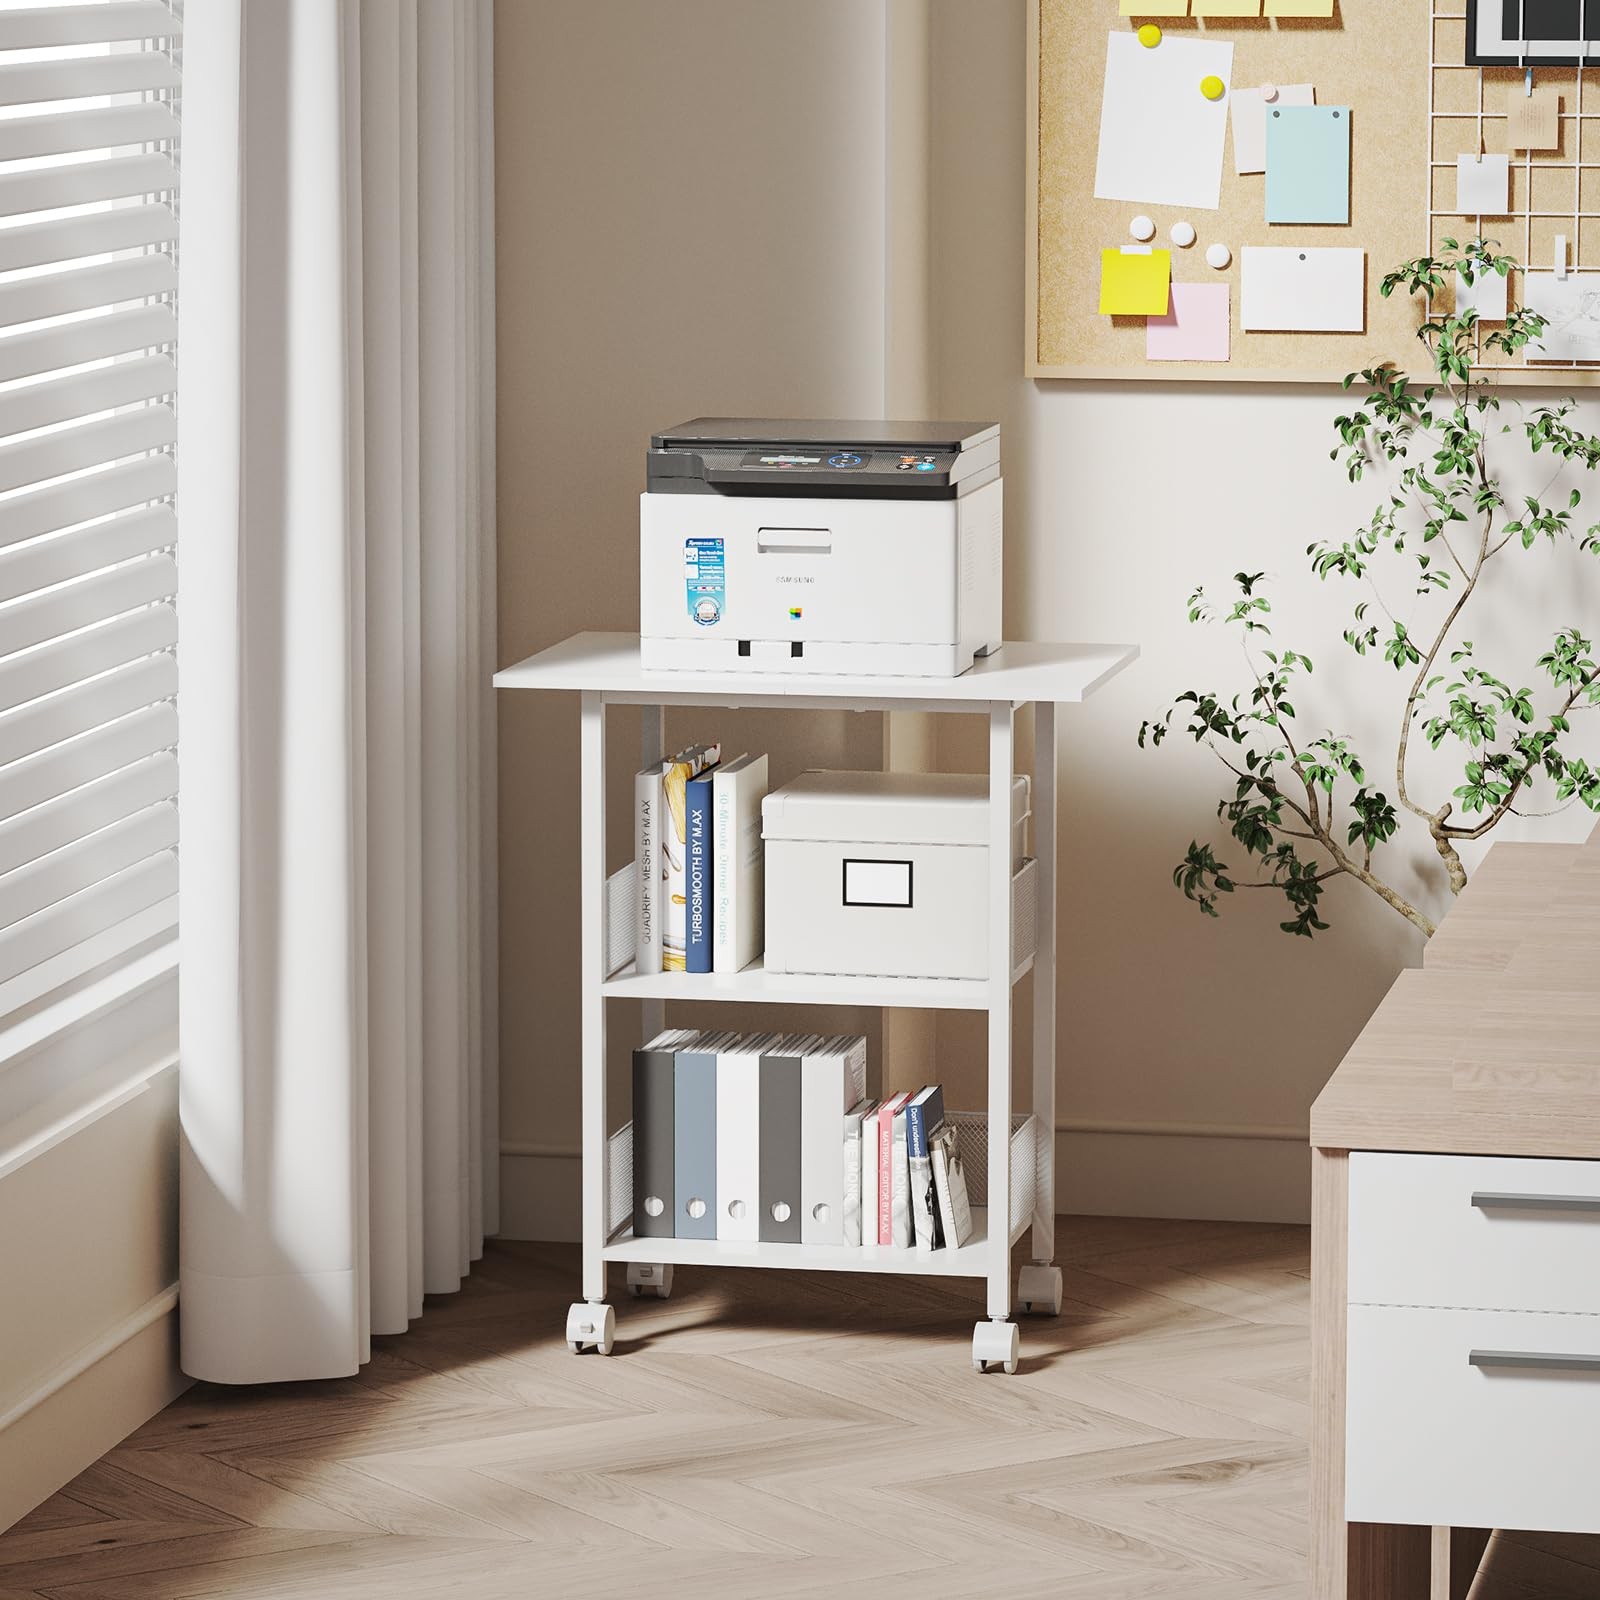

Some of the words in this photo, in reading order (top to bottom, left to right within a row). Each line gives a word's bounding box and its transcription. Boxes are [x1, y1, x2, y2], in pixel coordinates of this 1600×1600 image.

[641, 800, 651, 828] M.AX
[692, 809, 703, 837] M.AX
[641, 831, 651, 845] BY
[692, 839, 703, 855] BY
[641, 849, 651, 880] MESH
[641, 886, 651, 944] QUADRIFY
[692, 858, 703, 944] TURBOSMOOTH
[910, 1108, 919, 1125] Don't
[881, 1131, 889, 1169] MATERIAL
[881, 1171, 889, 1200] EDITOR
[881, 1202, 889, 1213] BY
